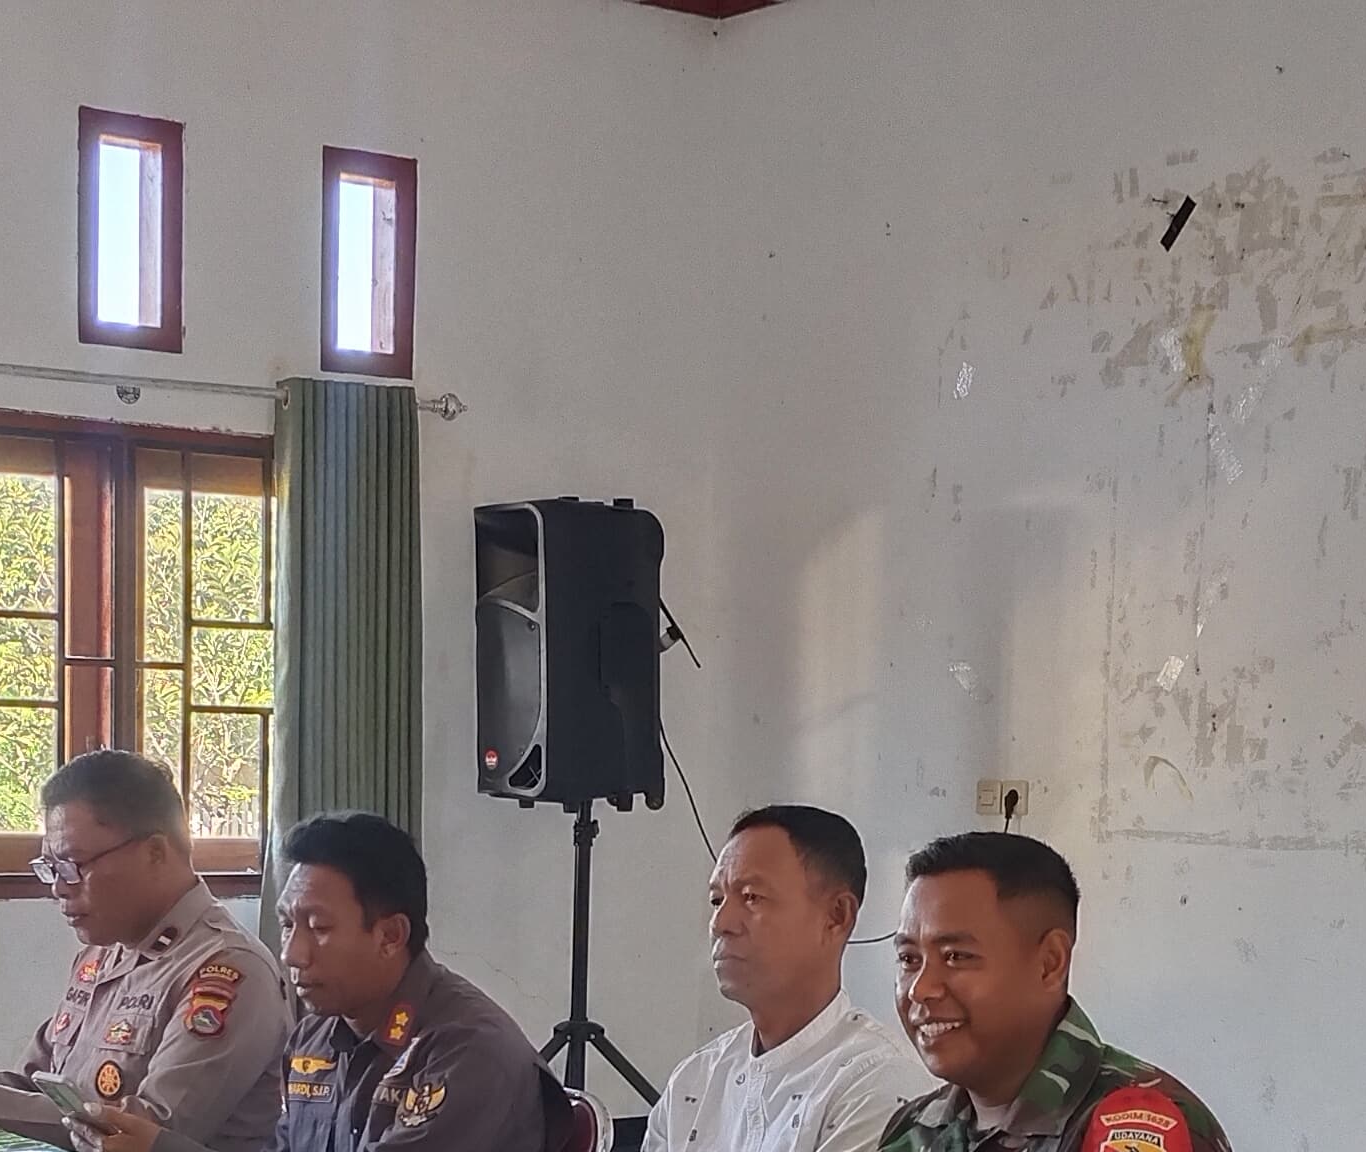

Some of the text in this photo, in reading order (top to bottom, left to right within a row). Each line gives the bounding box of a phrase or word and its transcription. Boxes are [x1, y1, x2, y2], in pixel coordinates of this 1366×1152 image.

[199, 965, 239, 981] POLRES
[1104, 1111, 1144, 1123] KODIM
[1114, 1131, 1159, 1144] UDAYANA
